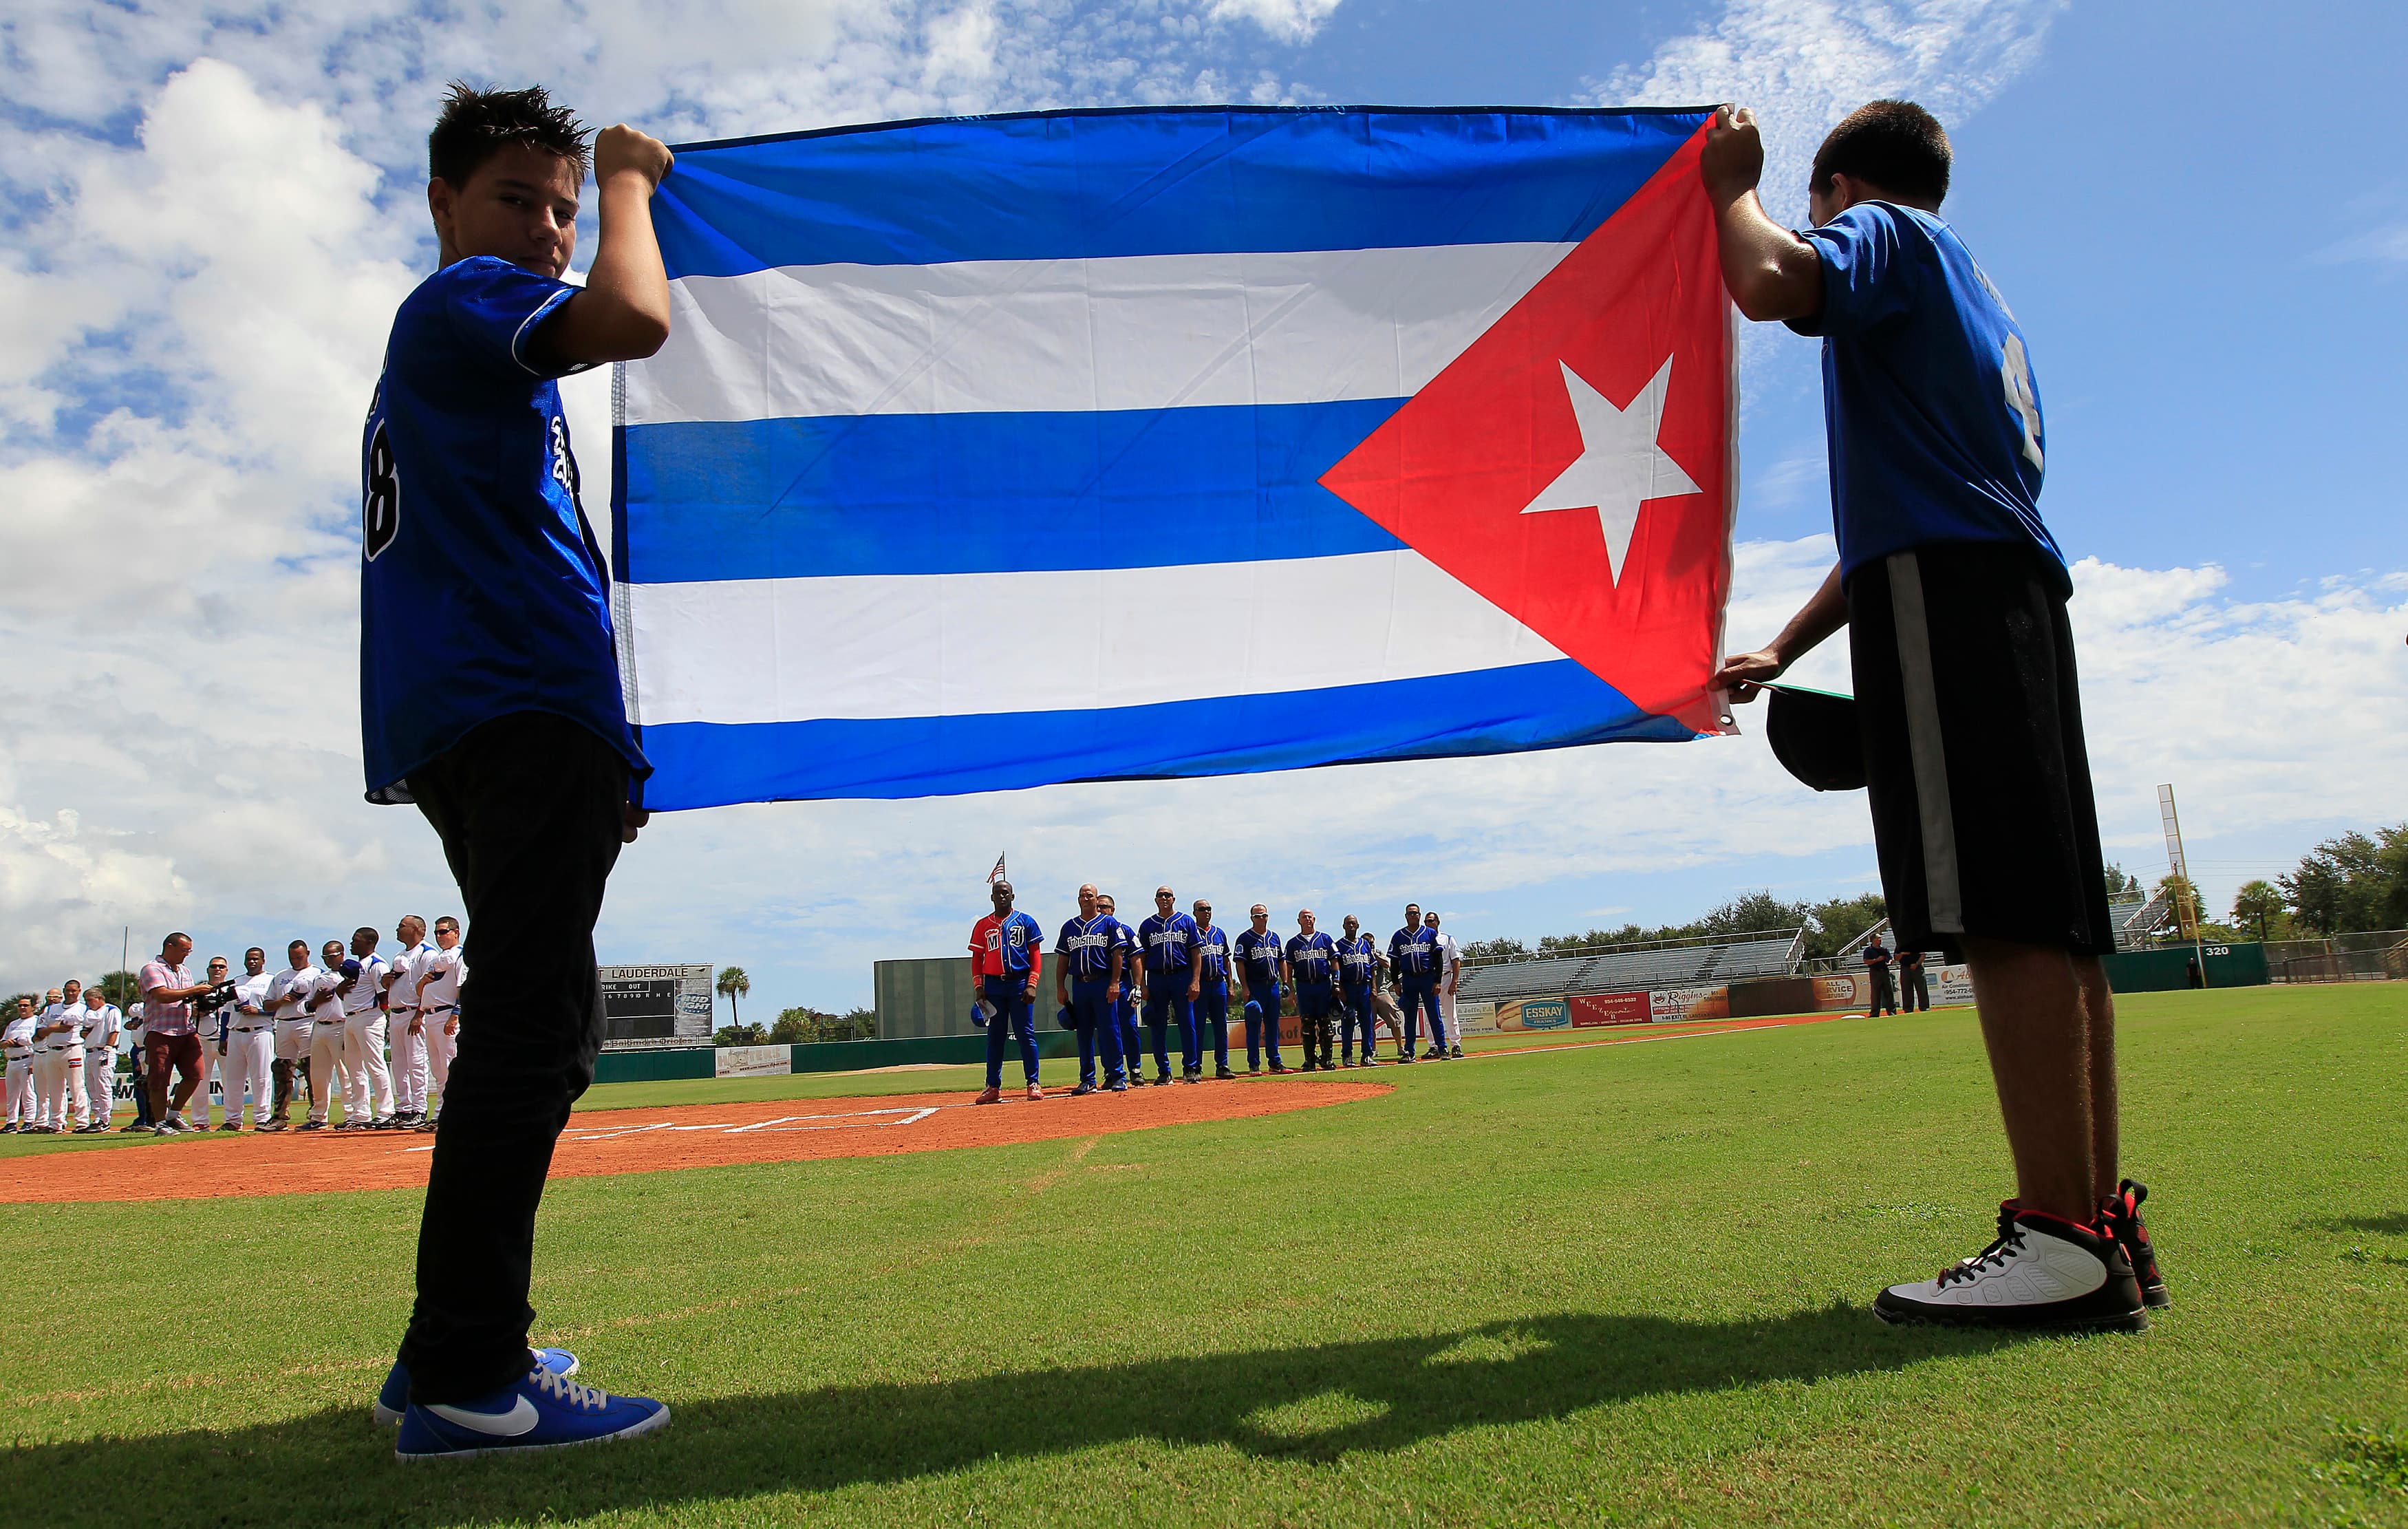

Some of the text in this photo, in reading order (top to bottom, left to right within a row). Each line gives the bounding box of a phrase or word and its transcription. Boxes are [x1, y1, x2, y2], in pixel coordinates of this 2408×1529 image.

[365, 418, 400, 562] 8
[987, 934, 999, 952] M
[2206, 946, 2229, 956] 320
[612, 968, 689, 979] LAUDERDALE
[683, 994, 709, 1003] BUD
[677, 1002, 711, 1010] LIGHT
[1526, 1006, 1562, 1018] ESSKAY
